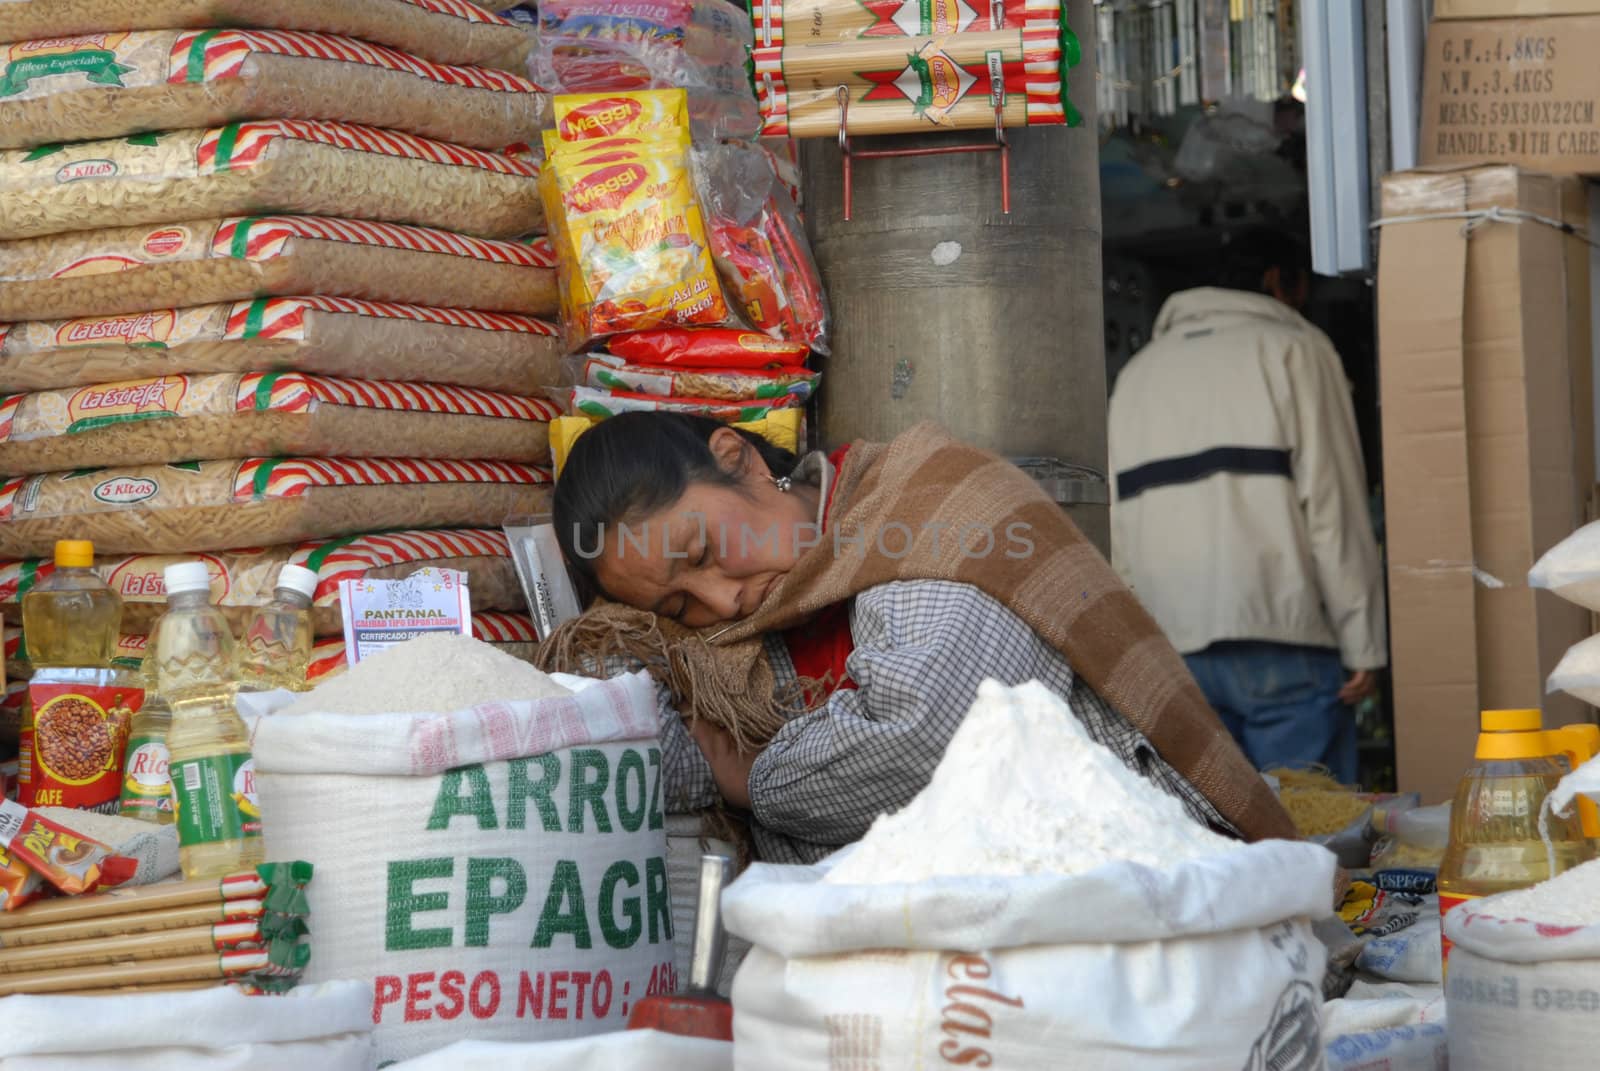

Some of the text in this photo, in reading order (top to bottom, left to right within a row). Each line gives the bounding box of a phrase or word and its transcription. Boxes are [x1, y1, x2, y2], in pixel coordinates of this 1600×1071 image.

[569, 104, 632, 136] Maggi
[574, 167, 637, 206] Maggi
[101, 484, 111, 495] 5
[365, 608, 447, 619] PANTANAL
[372, 970, 502, 1024] PESO
